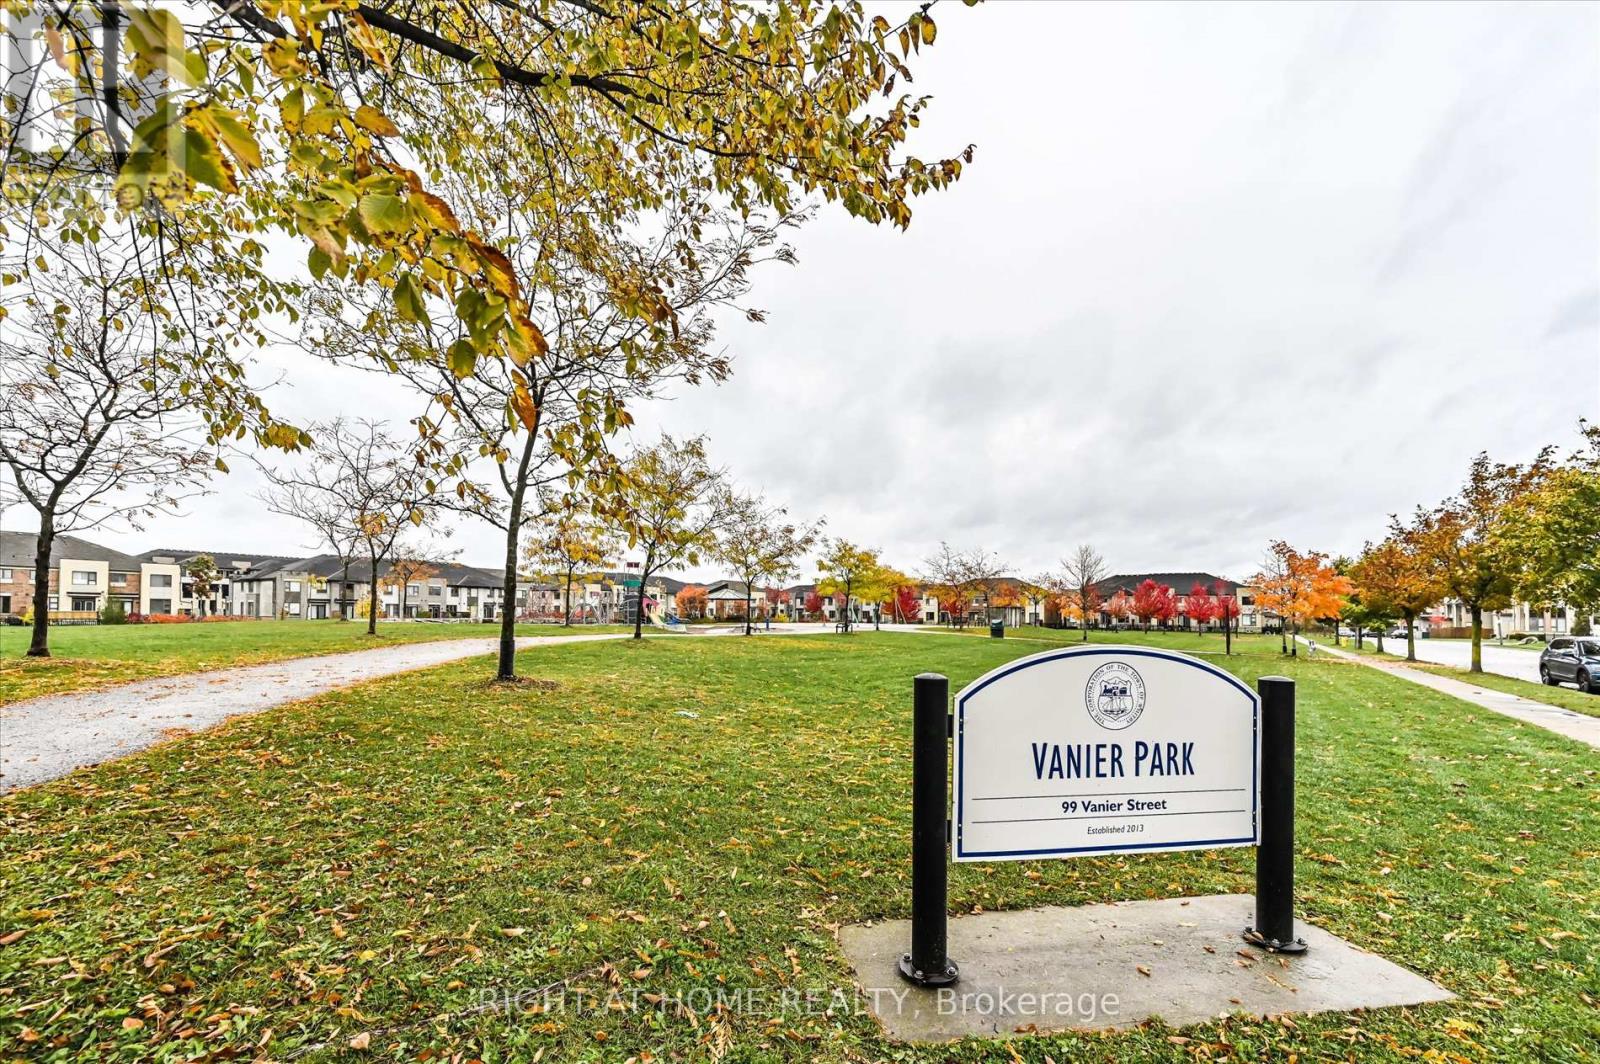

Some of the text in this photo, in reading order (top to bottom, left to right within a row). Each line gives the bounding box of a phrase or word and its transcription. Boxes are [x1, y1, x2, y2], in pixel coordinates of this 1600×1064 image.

[1095, 714, 1104, 725] THE
[1131, 671, 1143, 688] TOWN
[1061, 799, 1167, 813] 99 Vanier Street
[1087, 824, 1144, 834] Established 2013
